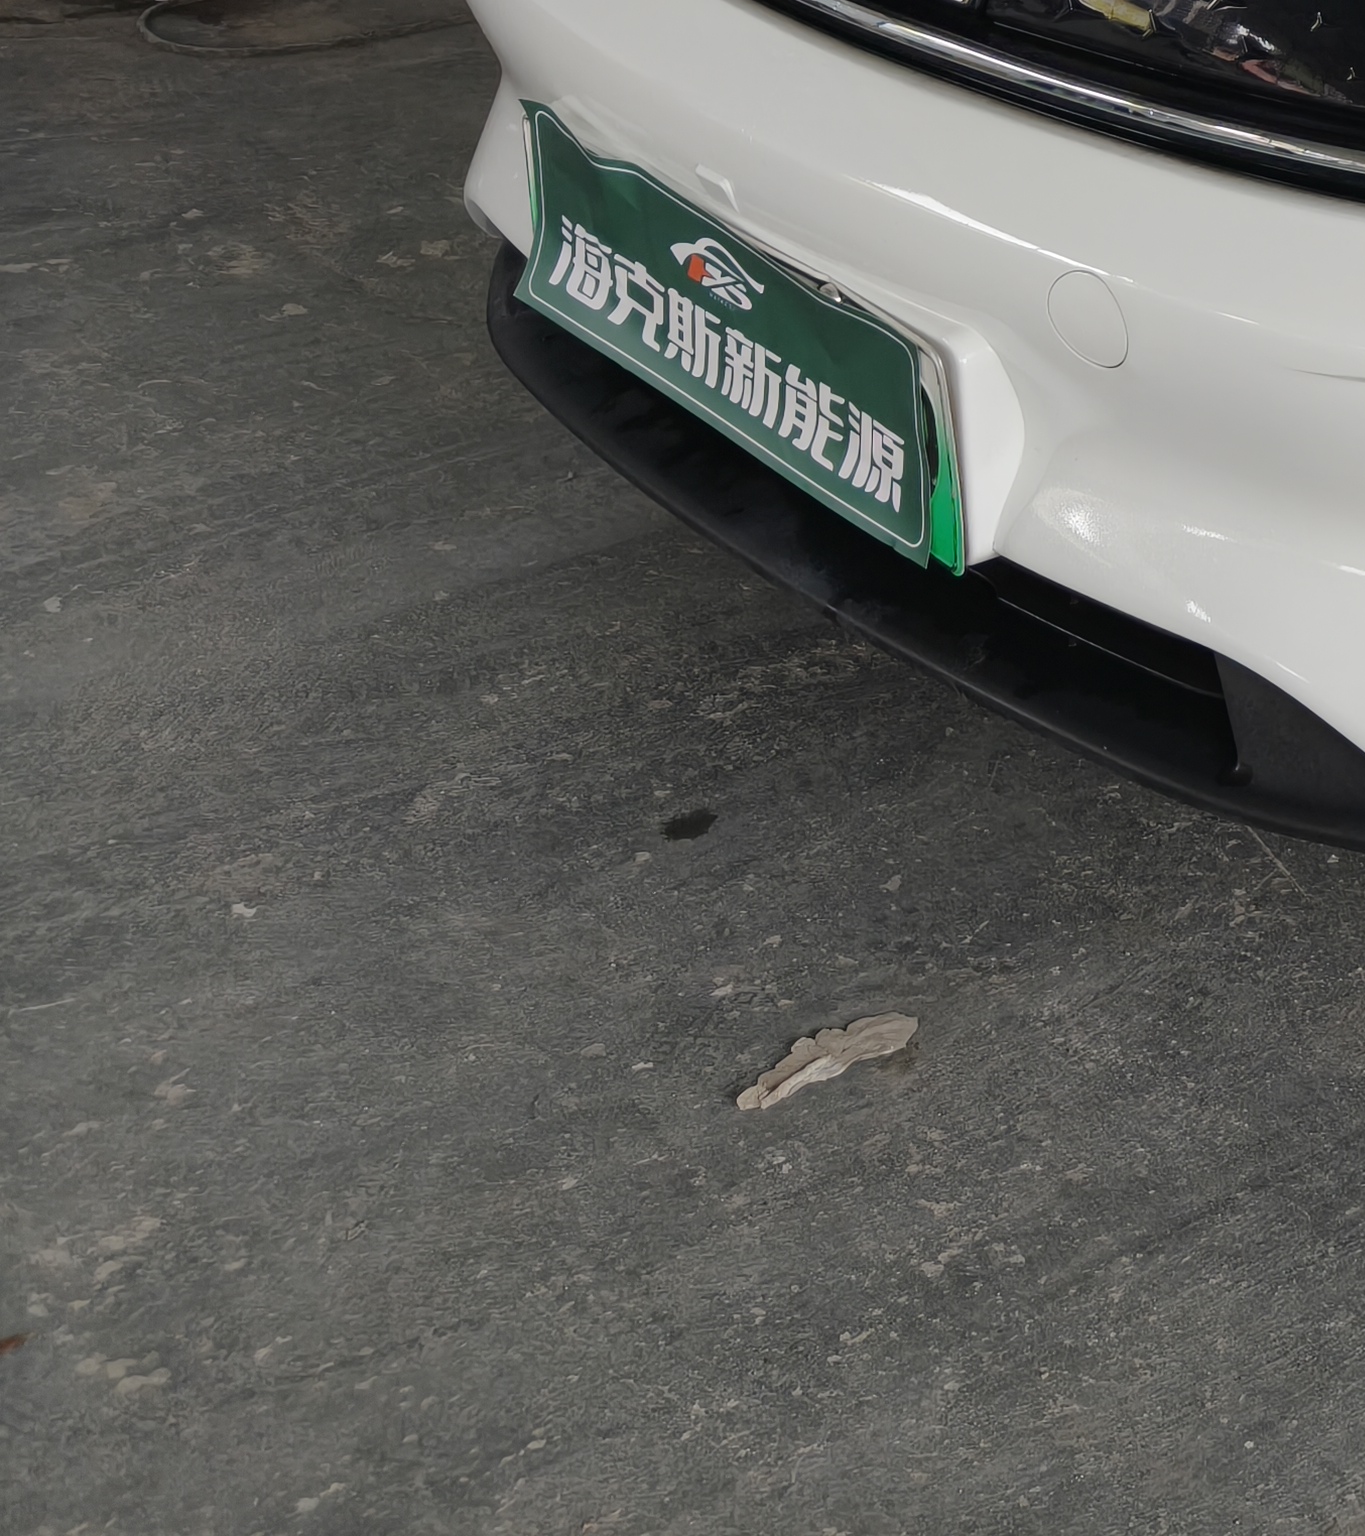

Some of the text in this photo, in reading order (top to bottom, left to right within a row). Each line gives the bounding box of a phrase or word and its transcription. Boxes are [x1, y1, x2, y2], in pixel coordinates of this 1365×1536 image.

[548, 214, 906, 513] 海克斯新能源
